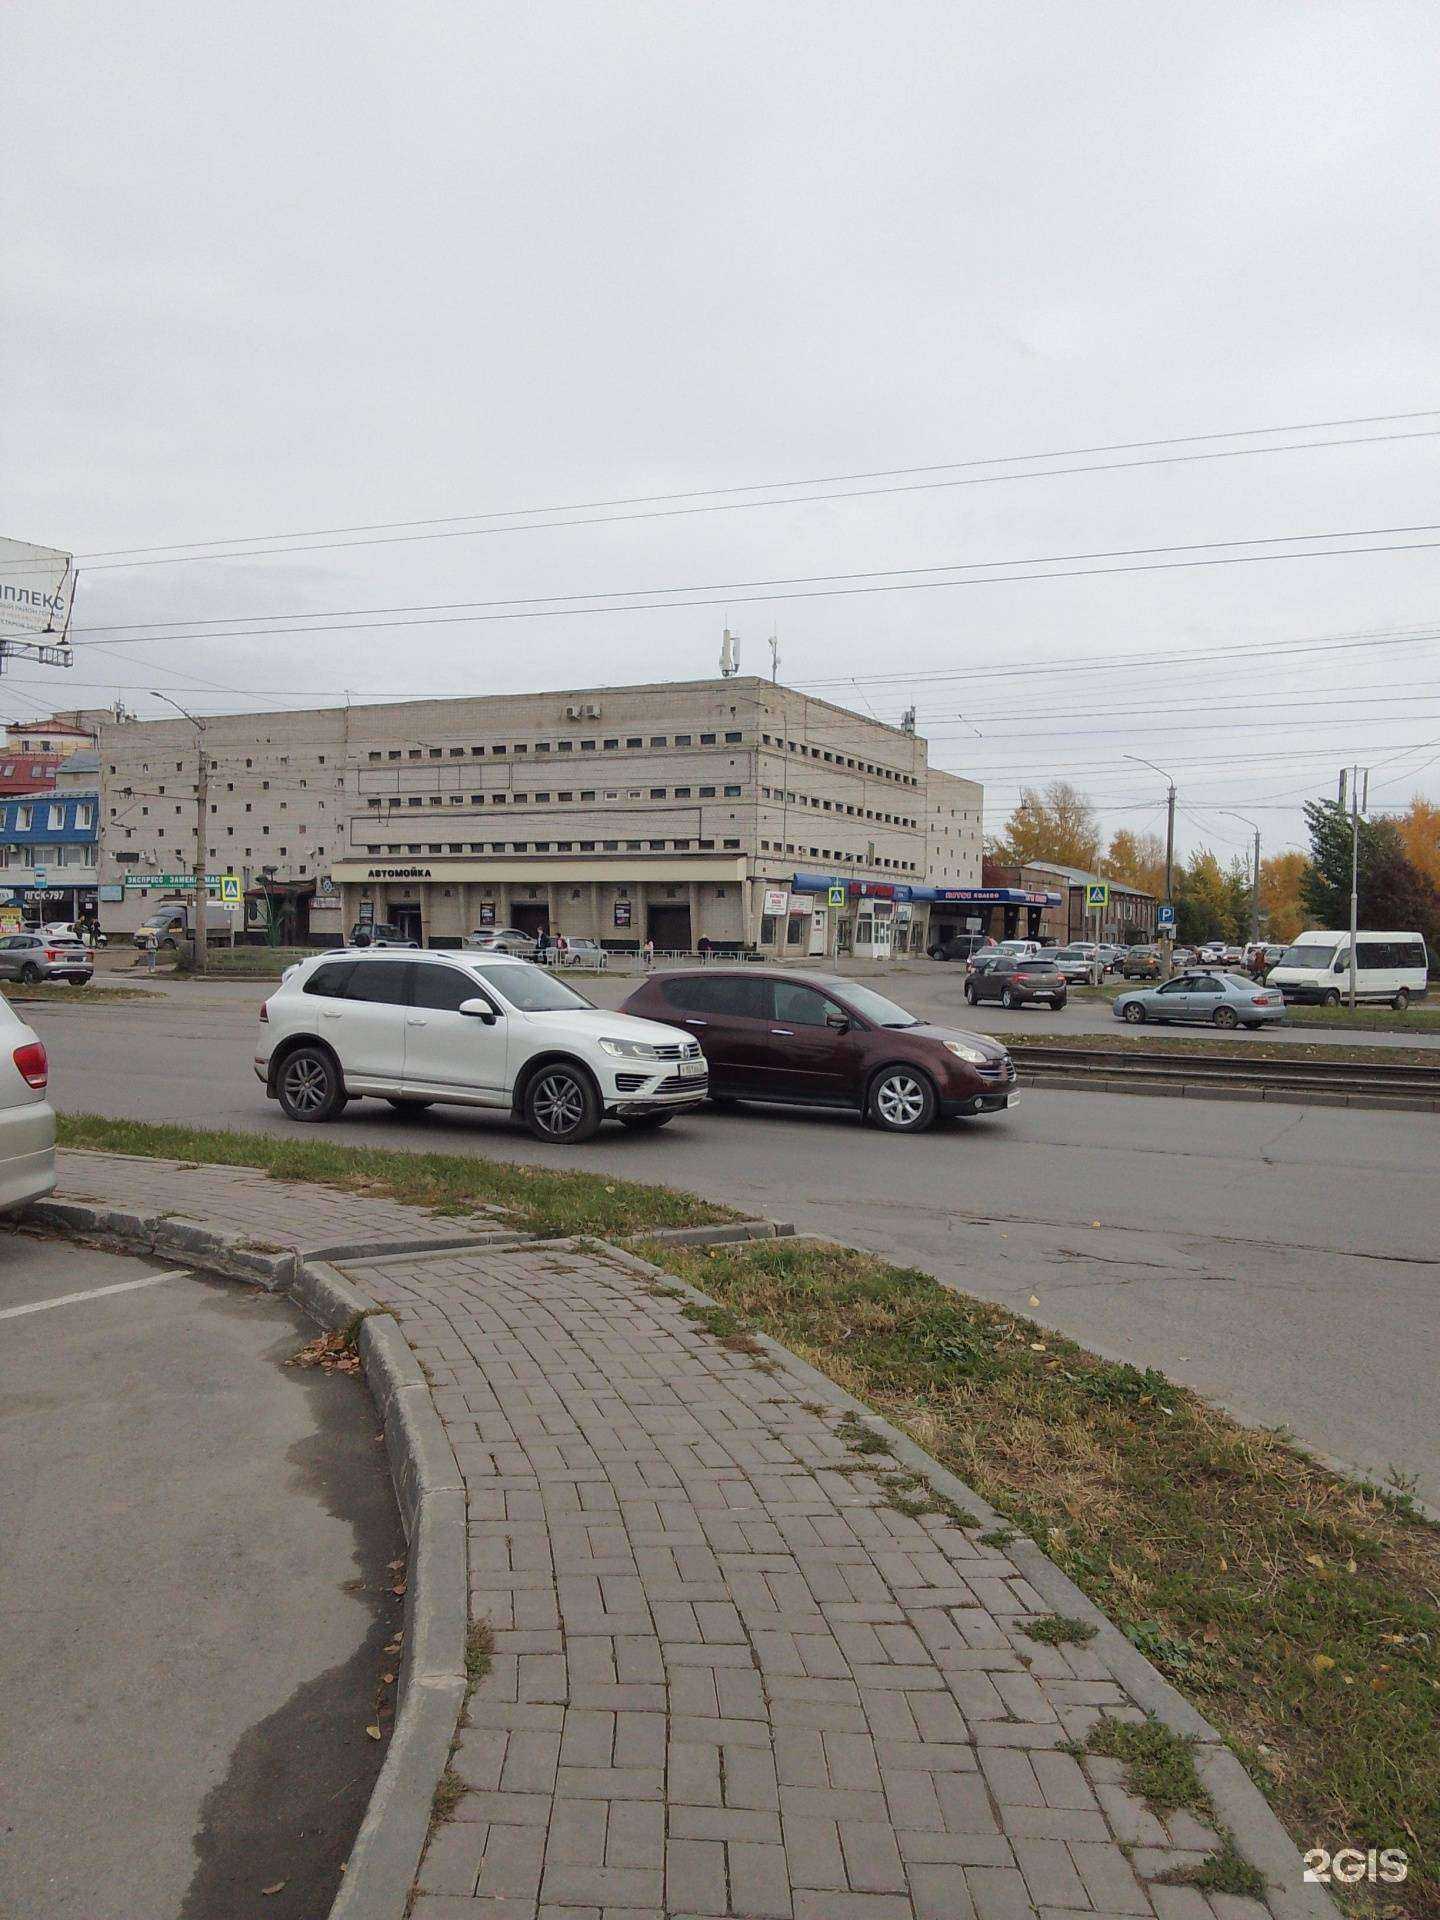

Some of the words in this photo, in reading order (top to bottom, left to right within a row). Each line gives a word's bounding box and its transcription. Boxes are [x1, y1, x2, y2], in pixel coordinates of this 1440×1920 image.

[0, 585, 65, 611] ПЛЕКС
[368, 866, 432, 878] АВТОМОЙКА
[128, 876, 164, 884] ЭКСПРЕСС
[24, 890, 65, 900] ПГСК-797
[1162, 908, 1172, 921] P
